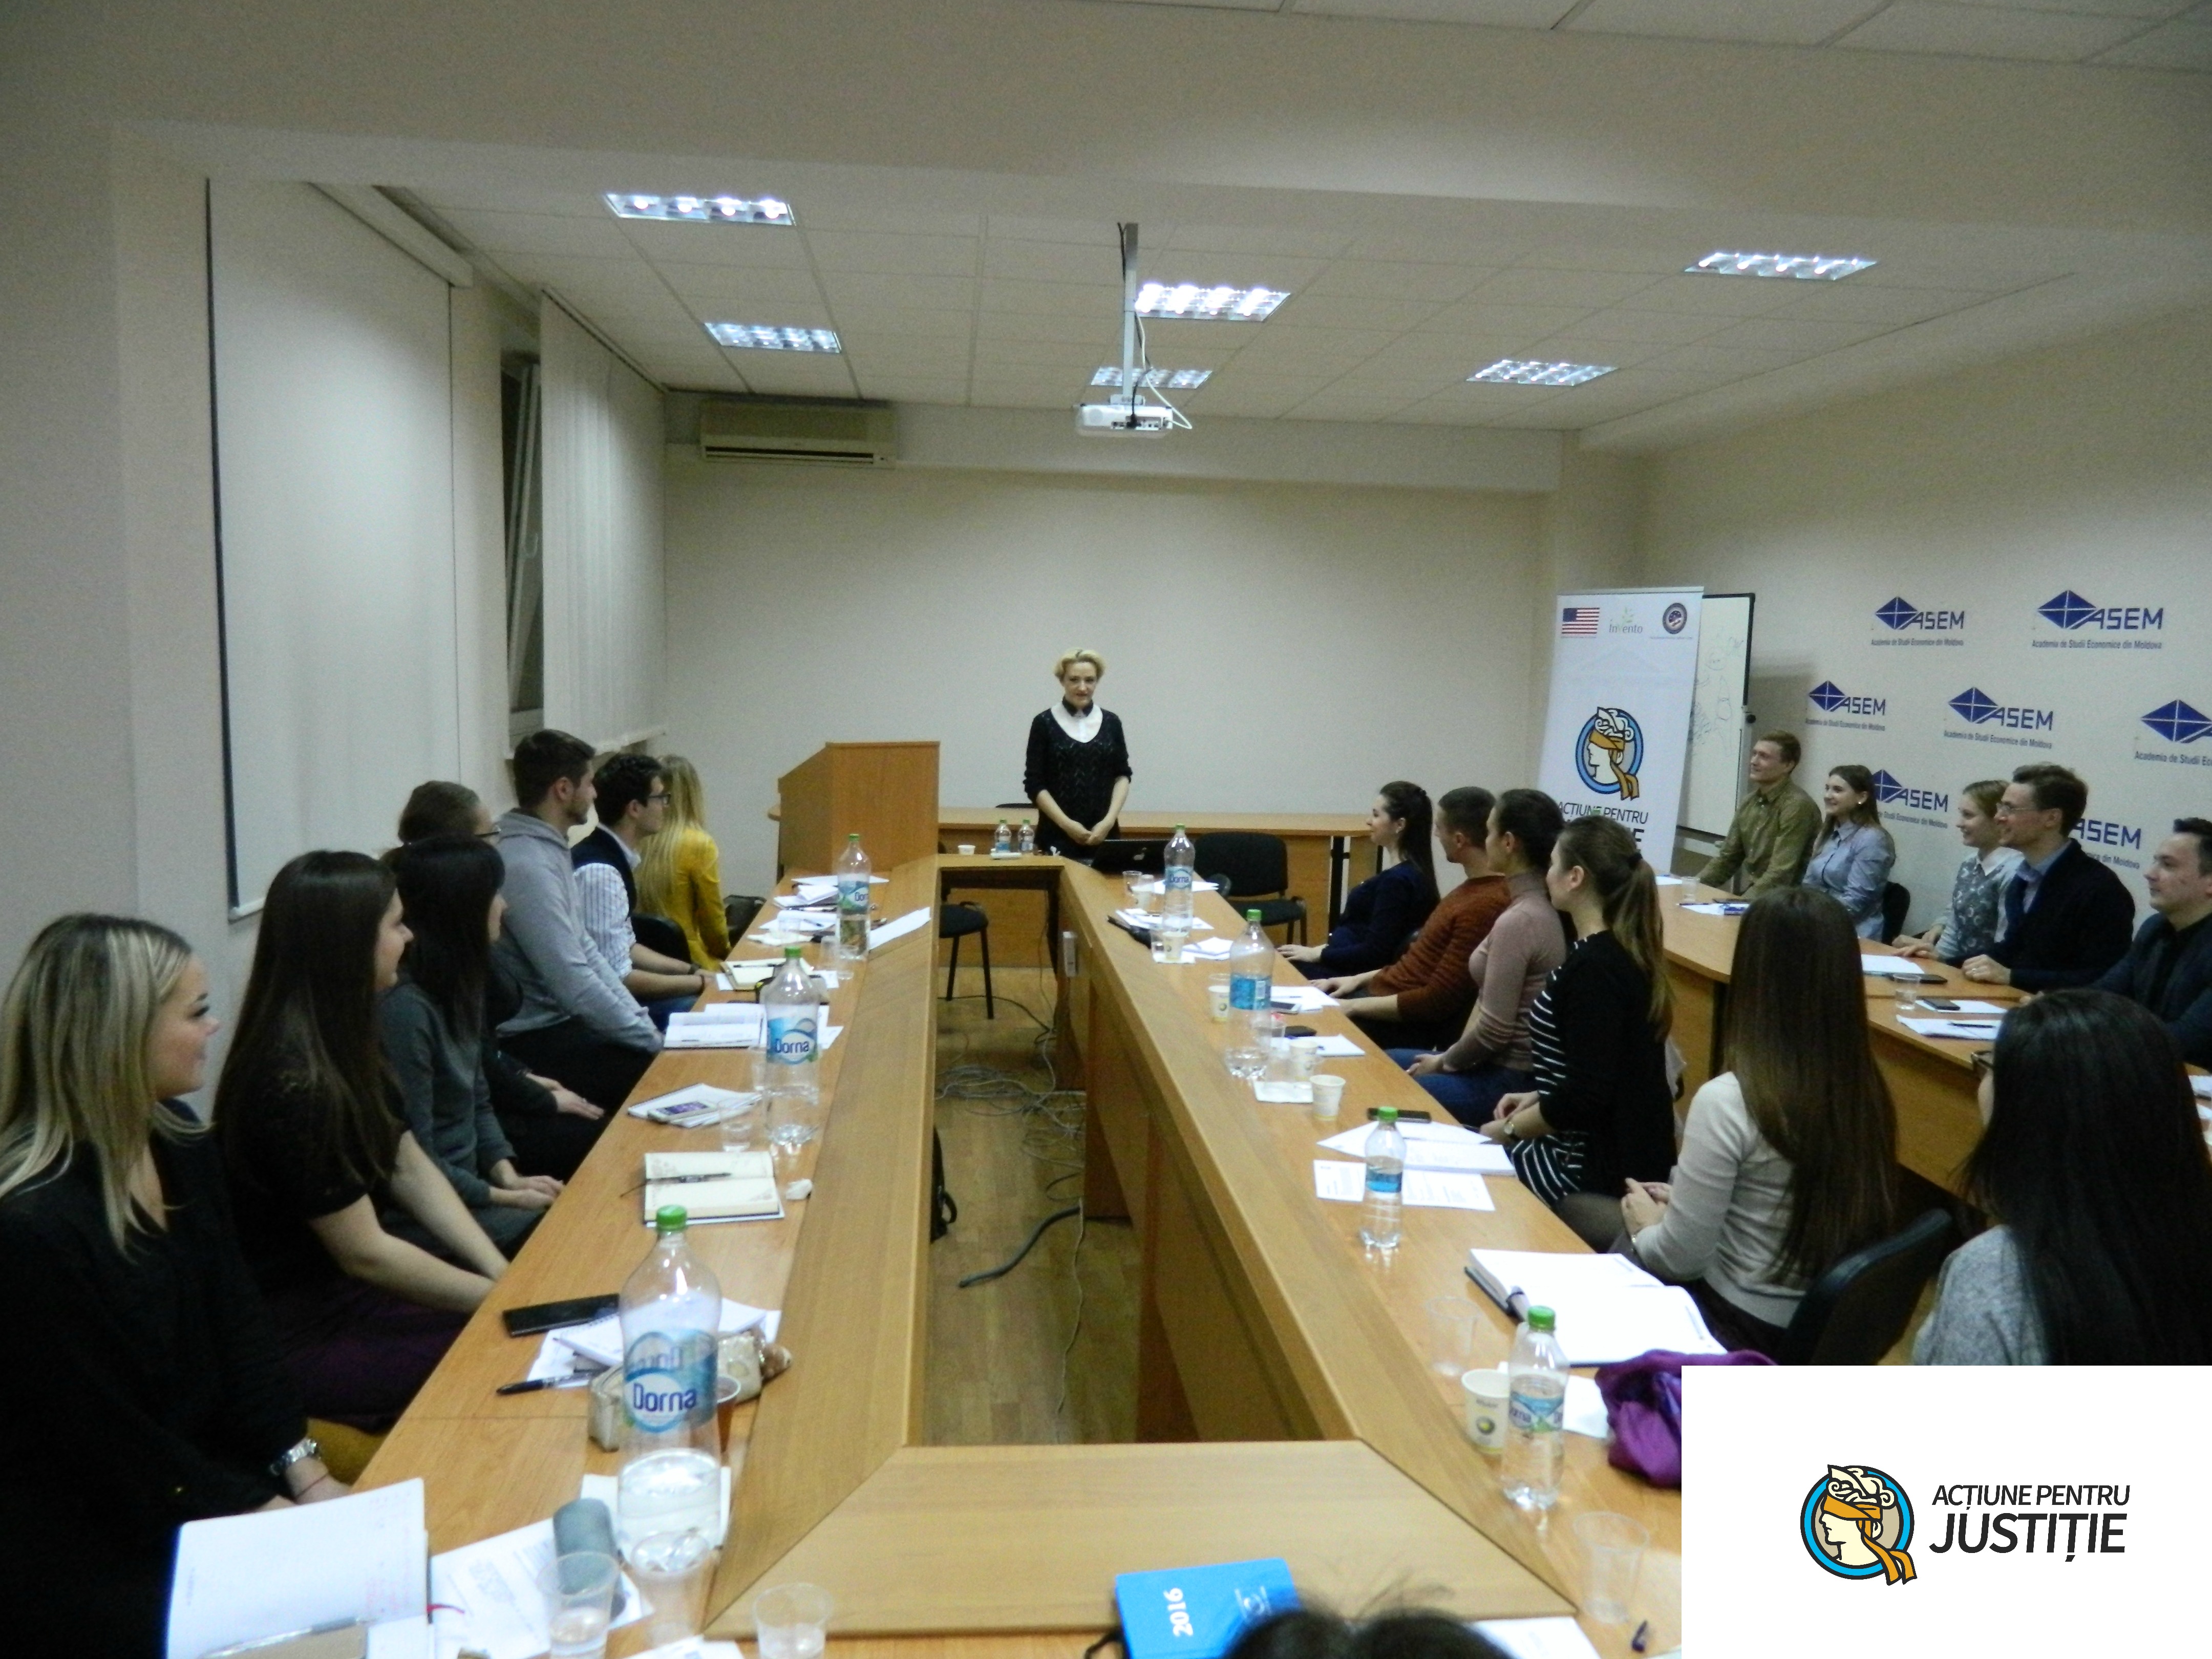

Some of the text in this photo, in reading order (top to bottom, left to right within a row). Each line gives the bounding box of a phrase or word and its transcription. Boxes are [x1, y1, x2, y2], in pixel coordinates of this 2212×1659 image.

[1898, 611, 1965, 630] ASEM
[2069, 608, 2164, 629] ASEM
[1830, 696, 1886, 716] ASEM
[1975, 707, 2053, 731] ASEM
[1884, 789, 1948, 813] ASEM
[775, 1038, 809, 1053] Dorna
[633, 1383, 697, 1412] Dorna
[1163, 1587, 1194, 1636] 2016
